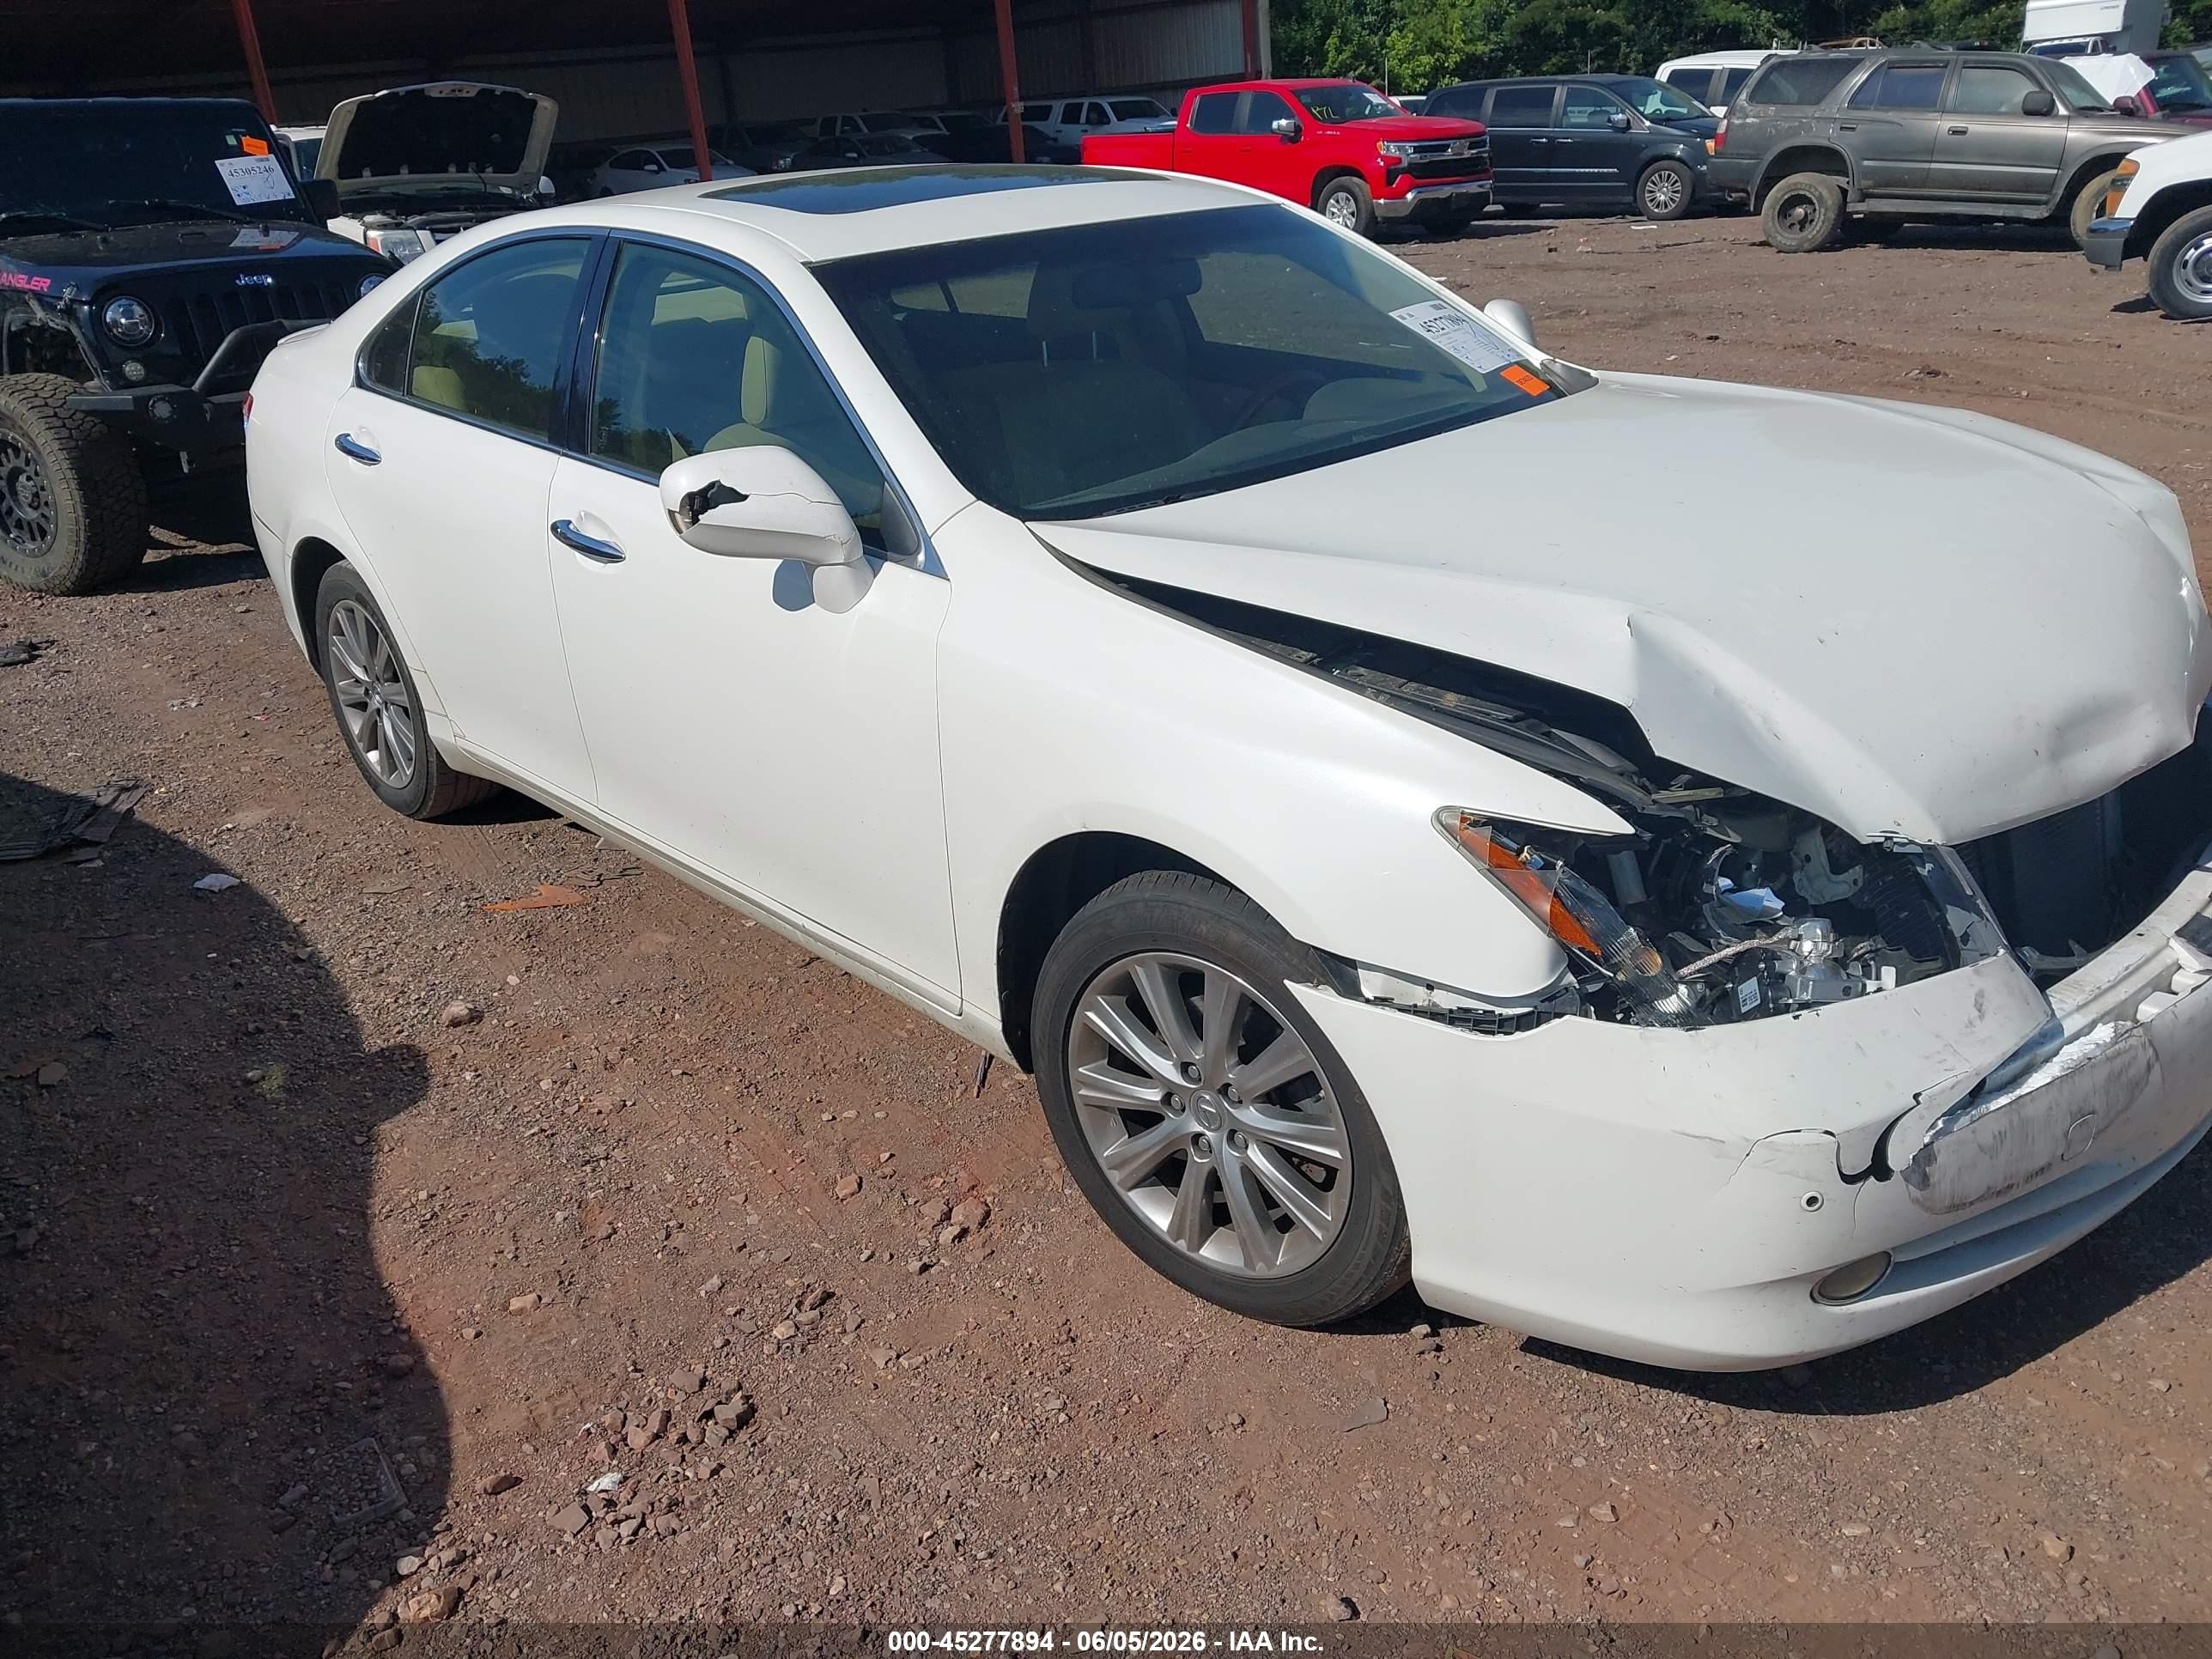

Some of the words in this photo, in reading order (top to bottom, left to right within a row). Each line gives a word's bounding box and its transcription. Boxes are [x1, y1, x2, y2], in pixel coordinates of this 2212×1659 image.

[228, 164, 275, 178] 45305246
[0, 273, 51, 292] ANGLER
[234, 273, 272, 286] Jeep
